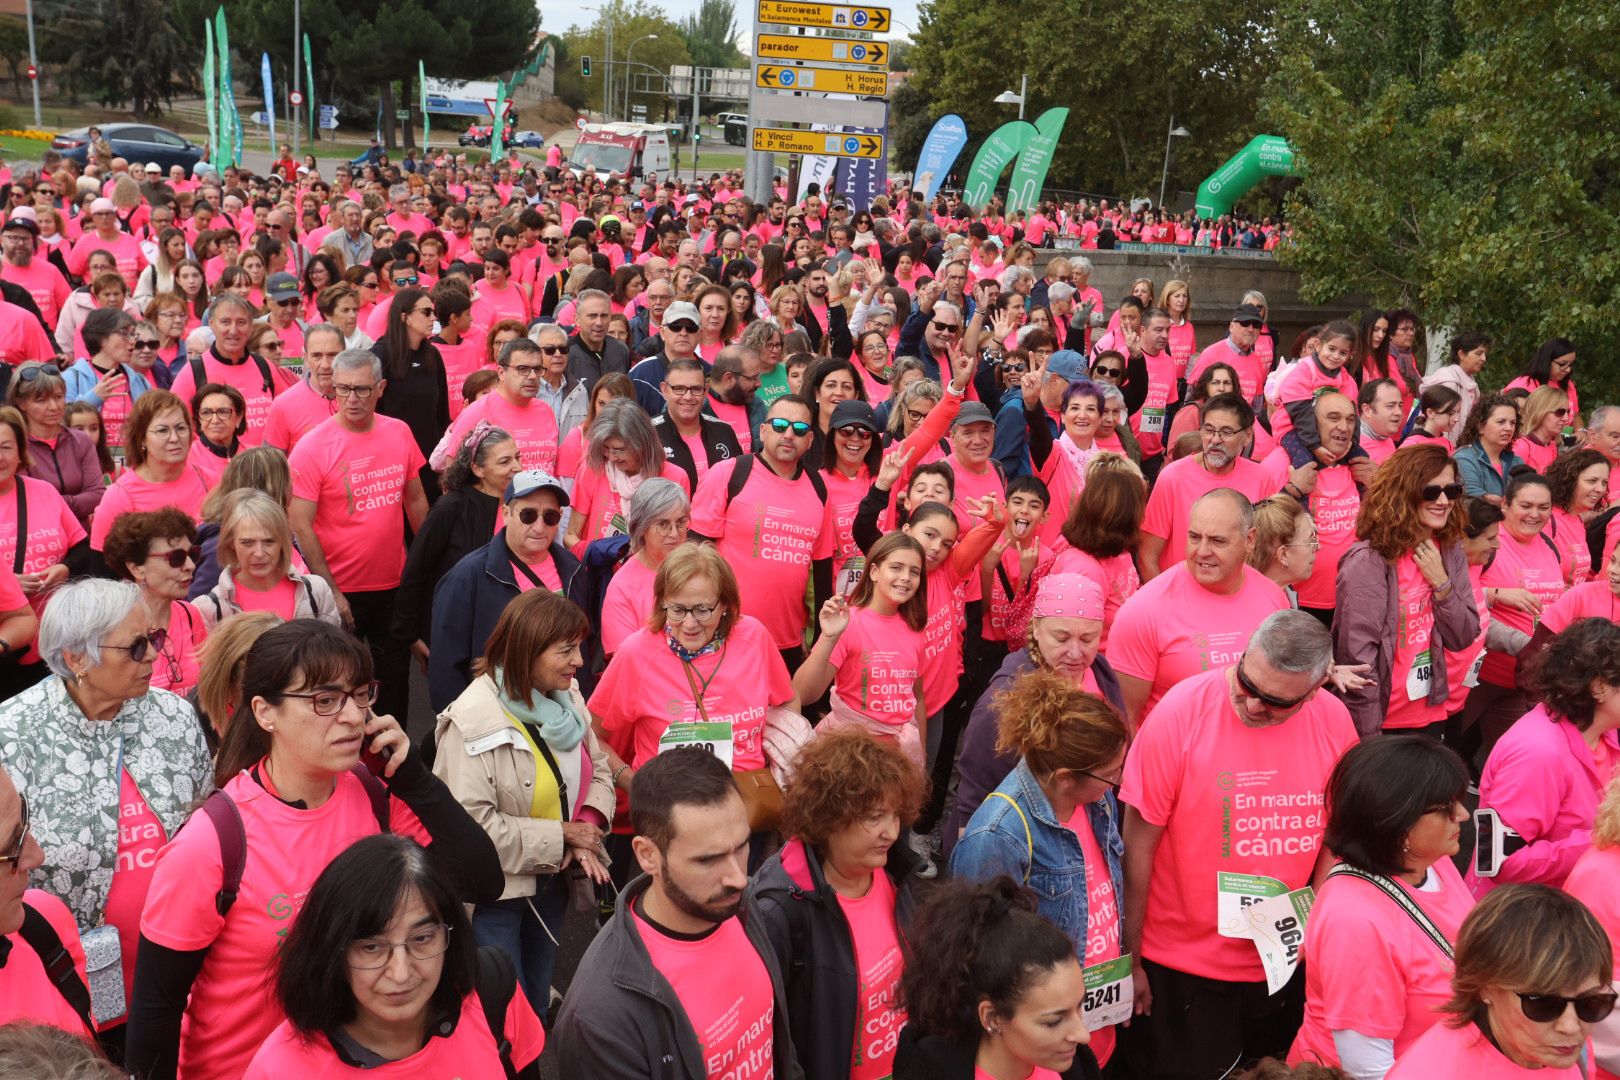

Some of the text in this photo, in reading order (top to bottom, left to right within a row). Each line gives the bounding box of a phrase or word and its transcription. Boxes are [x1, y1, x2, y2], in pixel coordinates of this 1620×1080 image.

[776, 4, 821, 16] Eurowest
[761, 42, 799, 52] parador
[858, 75, 884, 84] Horus
[859, 82, 883, 93] Regio
[768, 132, 794, 142] Vincci
[779, 142, 814, 151] Romano
[764, 385, 787, 397] Nice
[352, 463, 404, 484] En marcha
[354, 474, 405, 498] contra el
[355, 490, 403, 513] cánce
[764, 518, 781, 531] En
[48, 539, 64, 554] el
[761, 534, 807, 550] contra
[760, 547, 812, 566] cánce
[1210, 650, 1230, 664] En
[871, 667, 887, 679] En
[1234, 789, 1325, 810] En marcha
[1221, 796, 1231, 859] SALAMANCA
[1234, 808, 1322, 832] contra el
[1235, 832, 1321, 857] cáncer
[1274, 916, 1304, 966] 9641
[867, 990, 888, 1012] En
[1084, 982, 1122, 1013] 5241
[707, 997, 774, 1076] En marc
